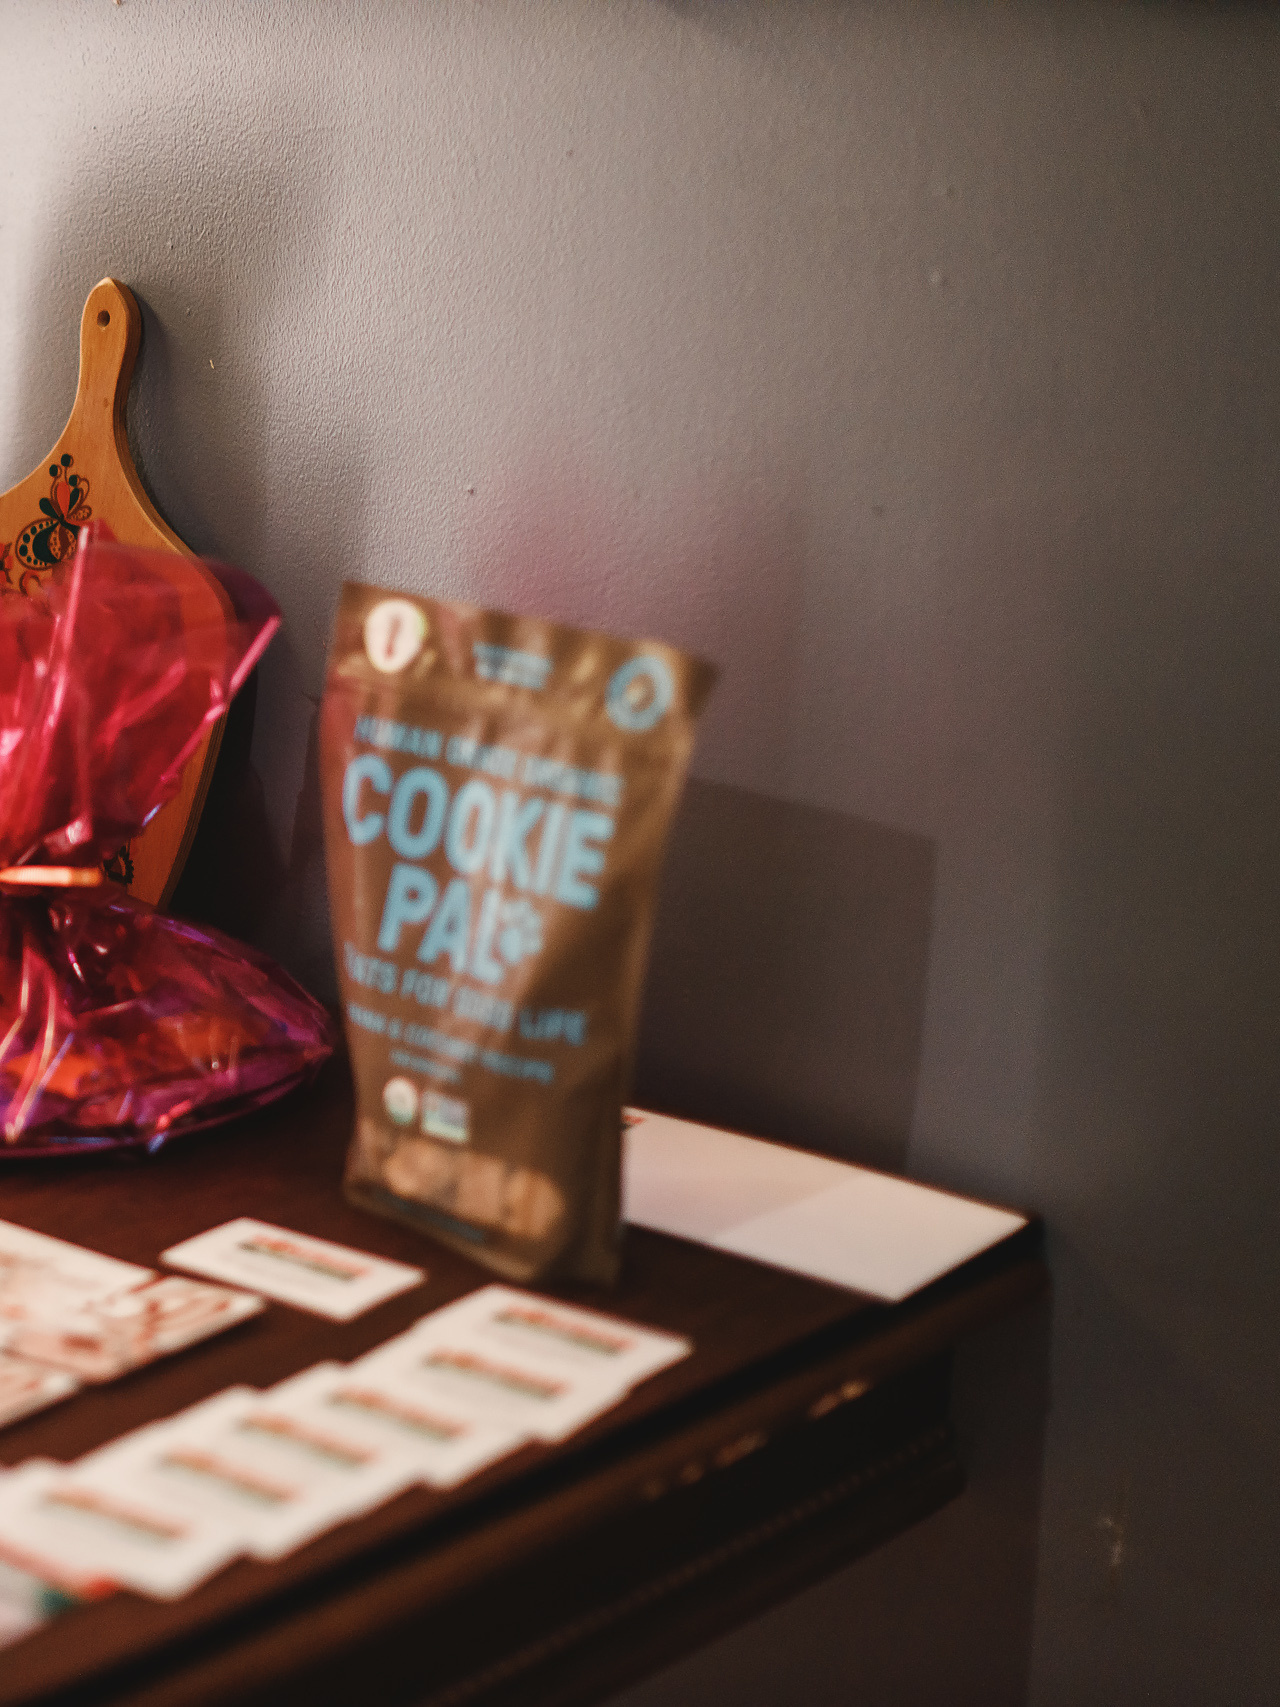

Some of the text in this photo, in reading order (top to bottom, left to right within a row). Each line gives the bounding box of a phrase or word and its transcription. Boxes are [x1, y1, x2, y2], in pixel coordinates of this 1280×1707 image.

[342, 754, 614, 909] COOKIE
[377, 864, 505, 984] PAL
[402, 971, 449, 1006] FOR
[519, 1009, 587, 1045] LIFE
